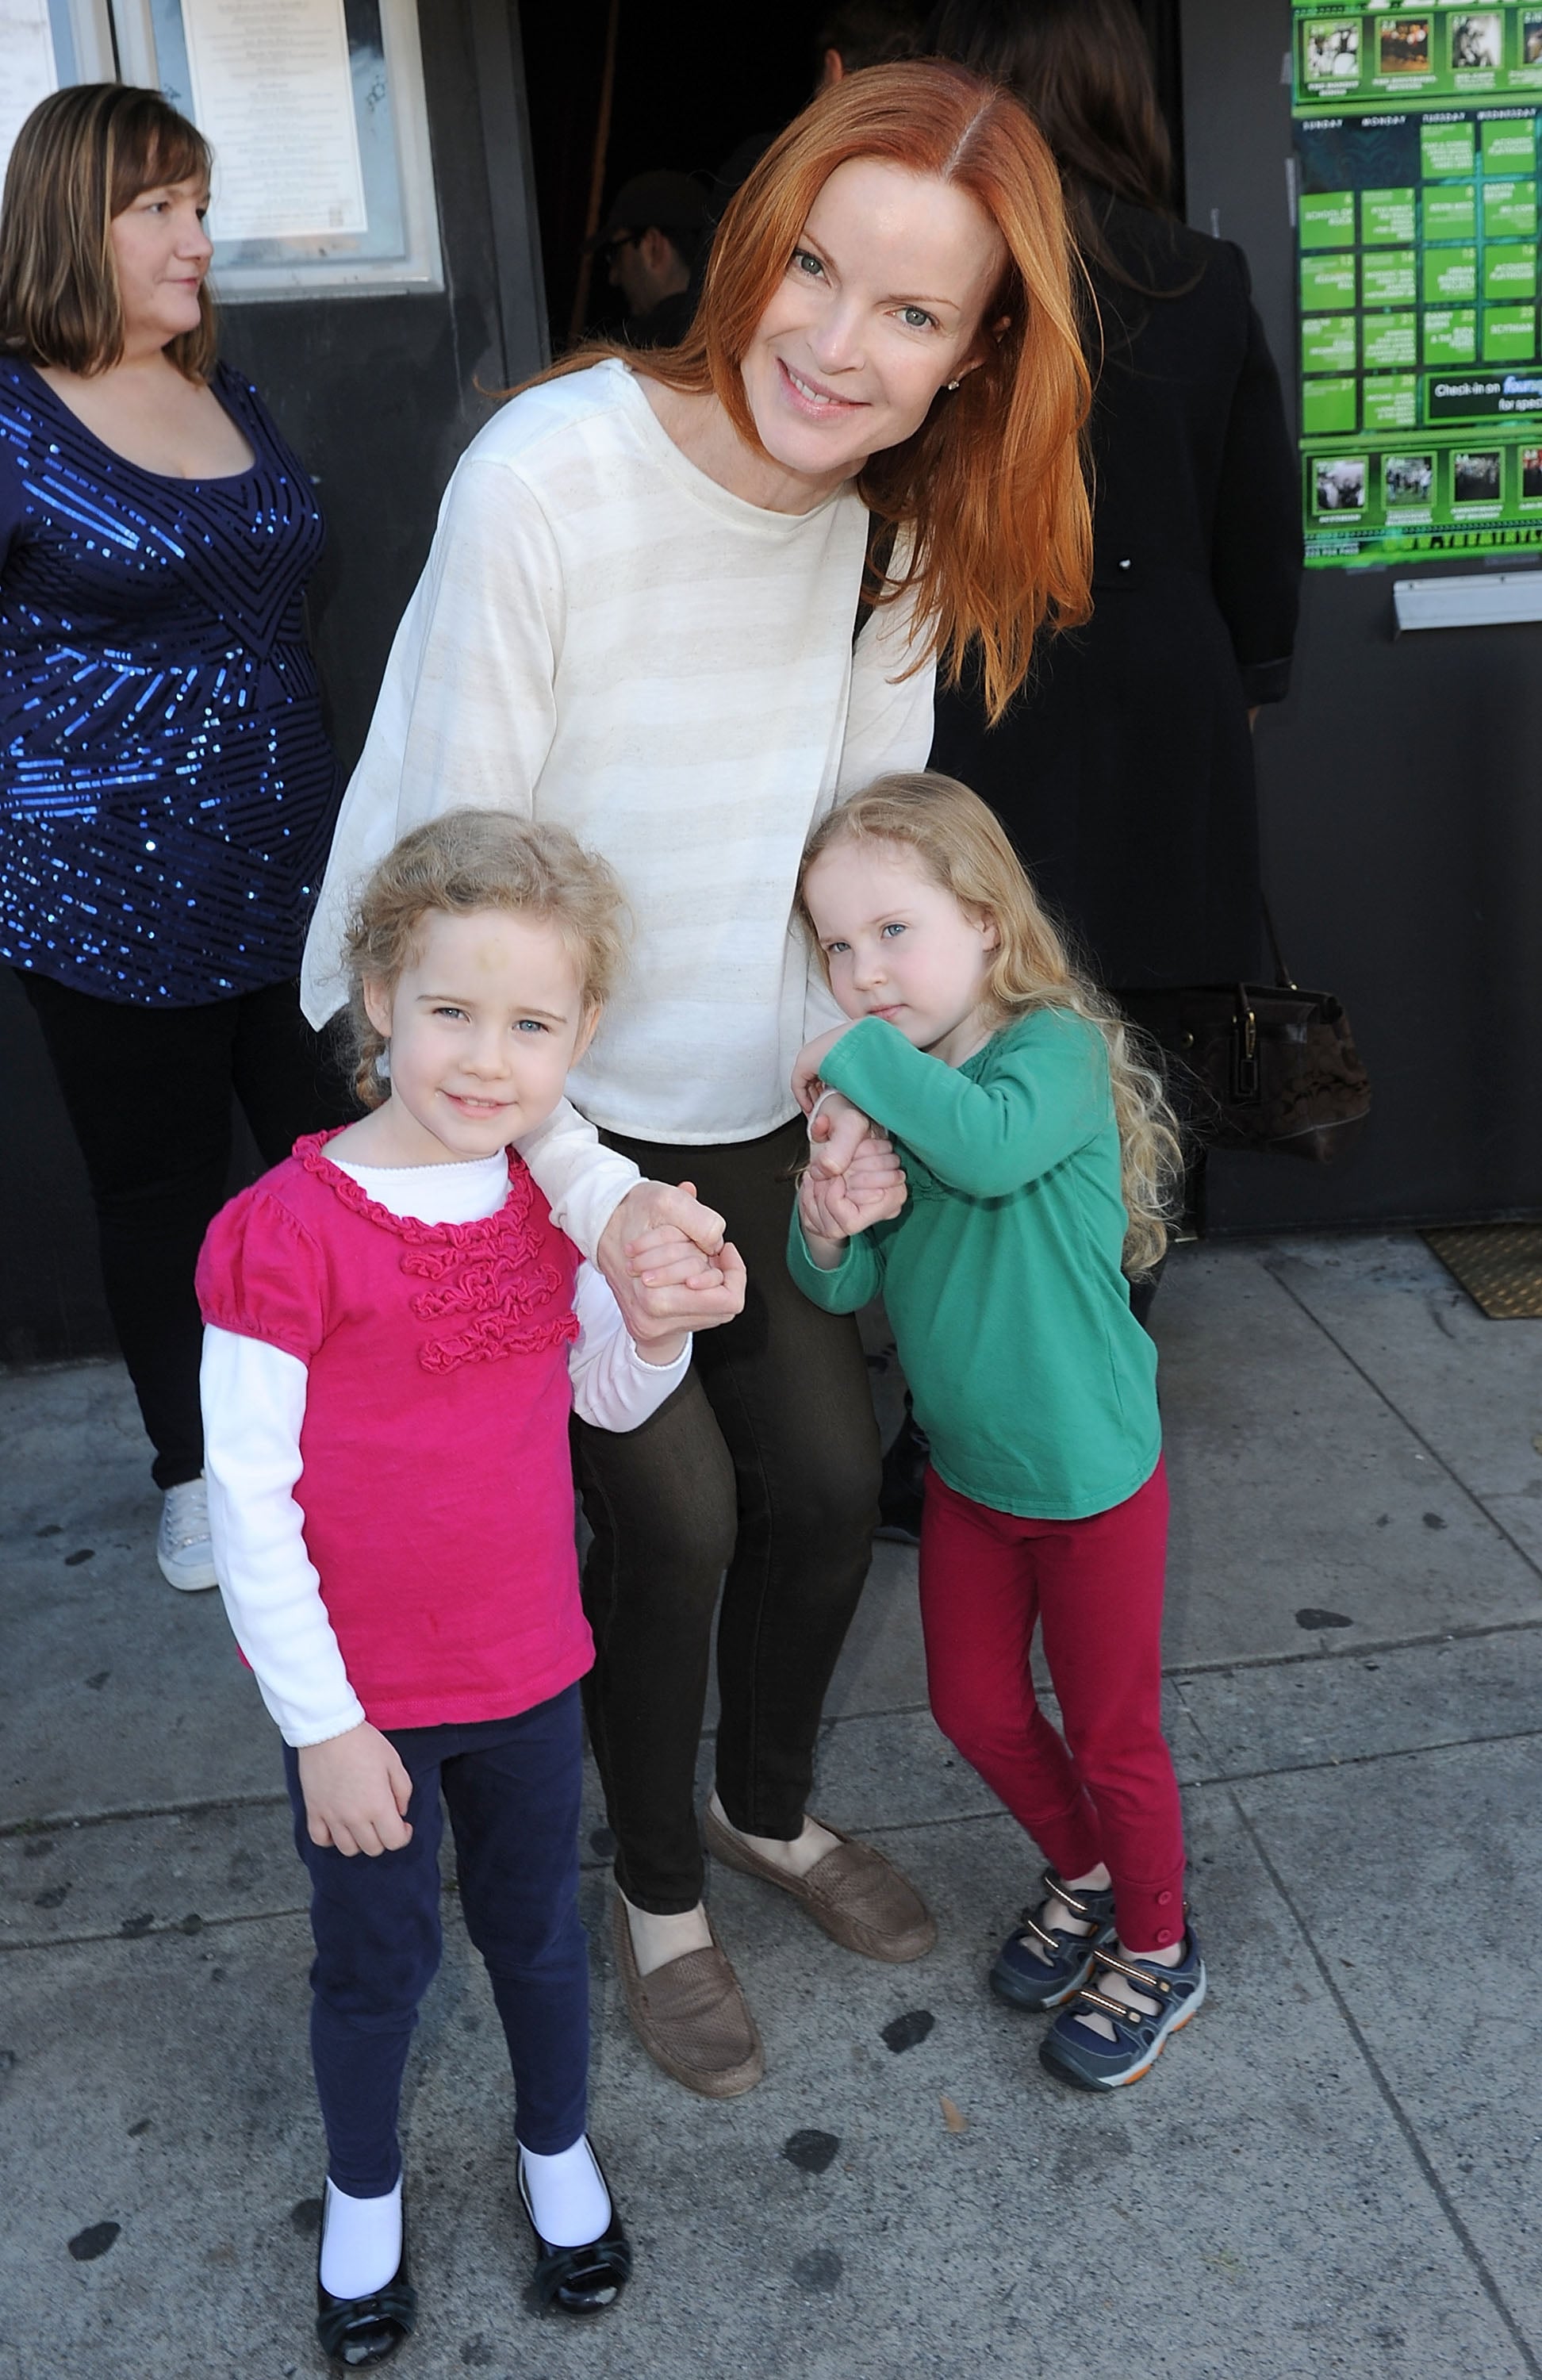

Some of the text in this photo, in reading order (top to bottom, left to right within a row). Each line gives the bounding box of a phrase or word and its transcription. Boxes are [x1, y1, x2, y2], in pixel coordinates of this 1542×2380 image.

[1302, 108, 1536, 131] SUNDAY MONDAY TUESDAY WEDNESDAY
[1498, 398, 1514, 411] for
